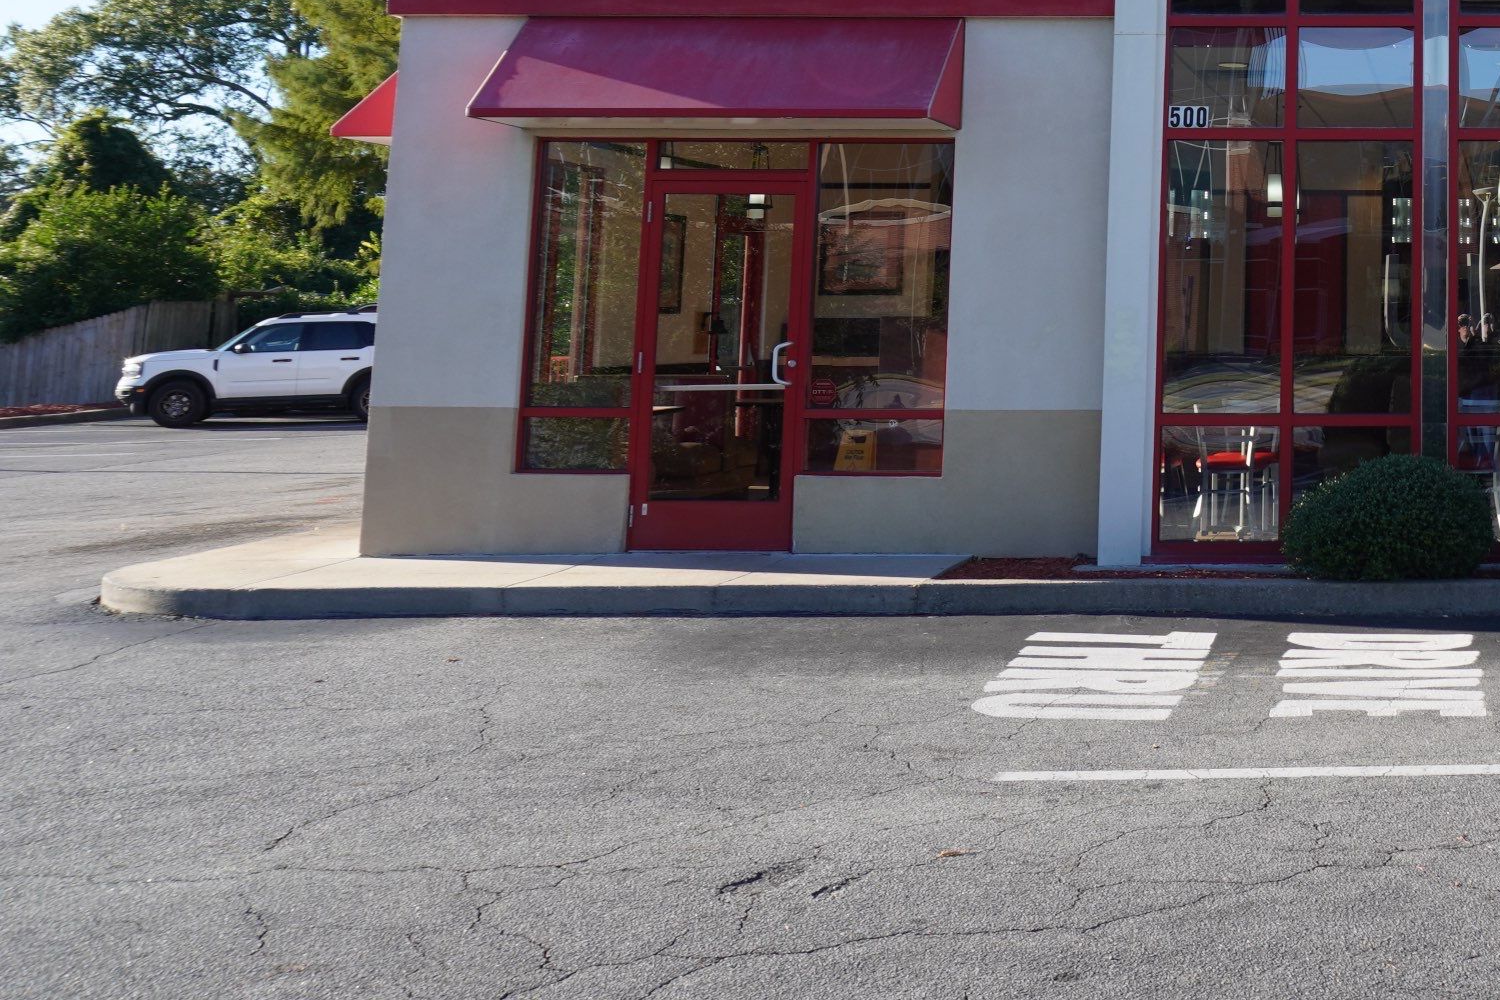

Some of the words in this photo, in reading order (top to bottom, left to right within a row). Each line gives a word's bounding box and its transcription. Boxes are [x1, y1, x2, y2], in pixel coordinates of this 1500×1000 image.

[1170, 106, 1206, 127] 500
[971, 631, 1217, 720] THRU
[1269, 632, 1487, 717] DRIVE
